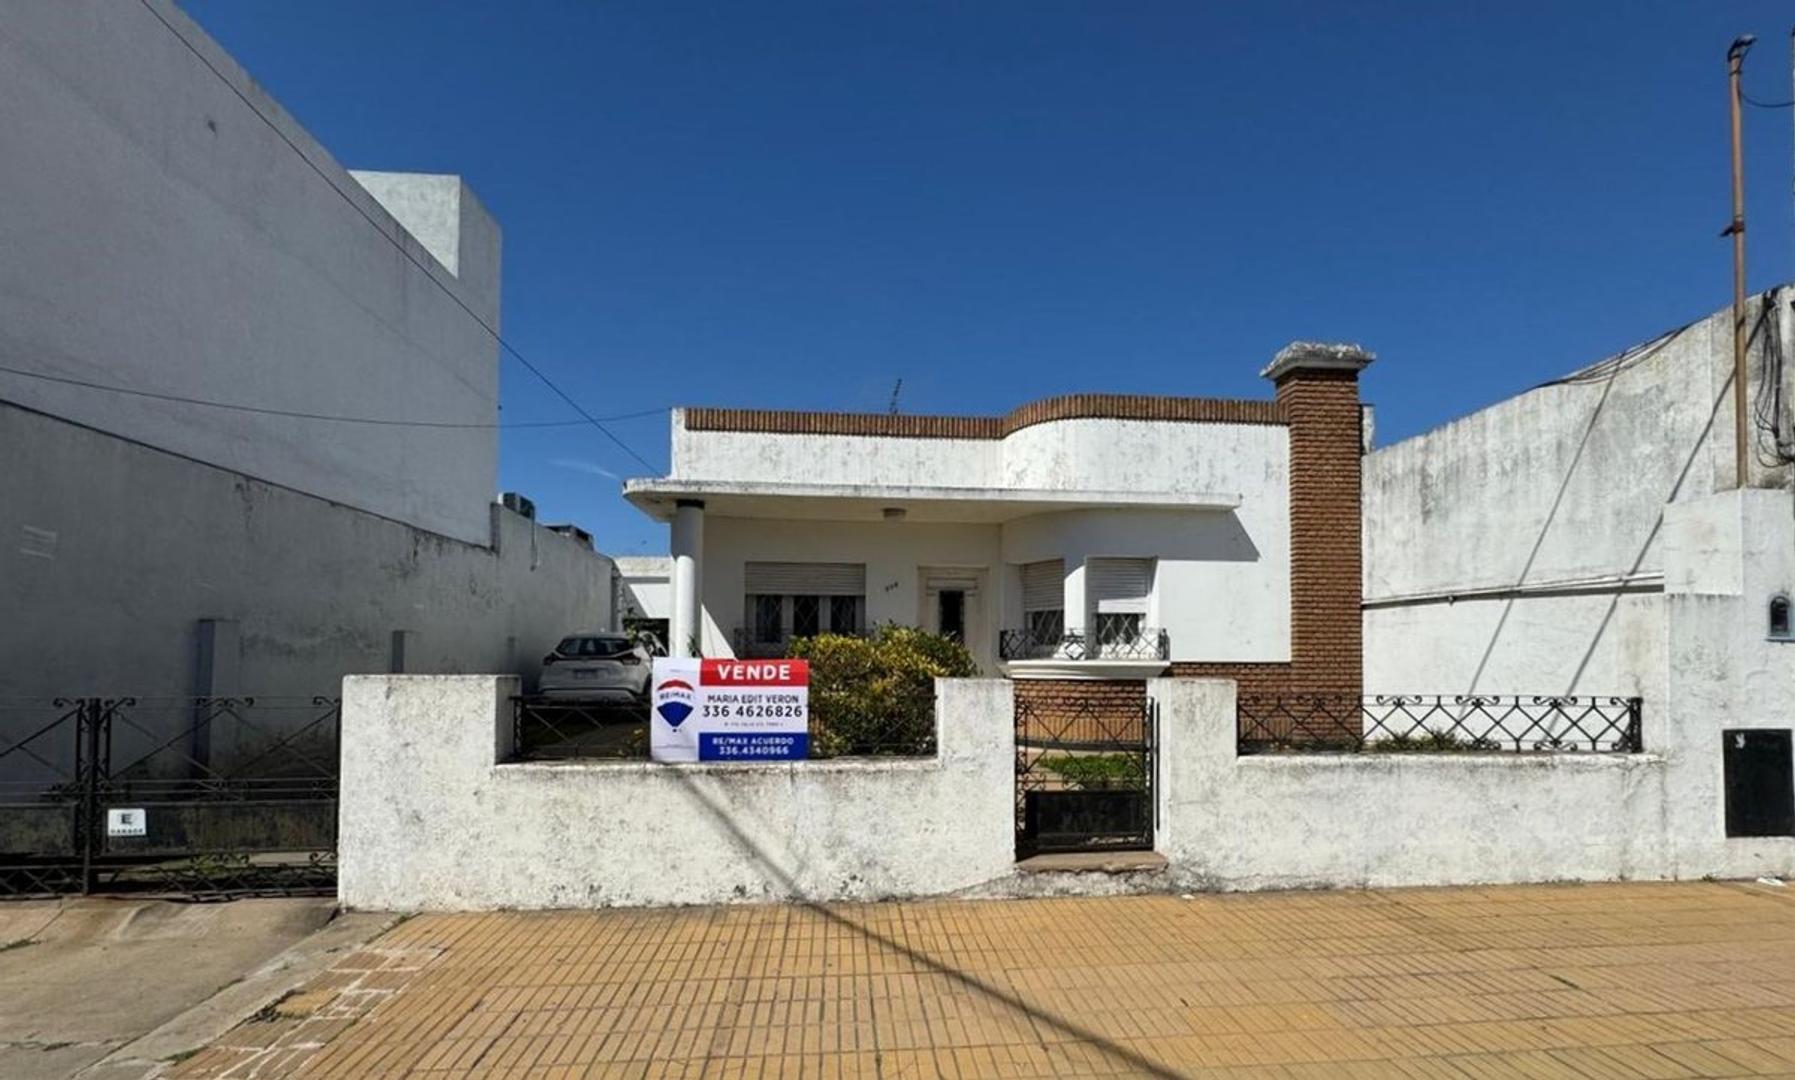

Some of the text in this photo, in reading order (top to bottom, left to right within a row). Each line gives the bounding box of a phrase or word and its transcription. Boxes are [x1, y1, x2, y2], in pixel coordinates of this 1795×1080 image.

[717, 664, 791, 680] VENDE
[707, 695, 799, 703] MARIA EDIT VERON
[702, 705, 803, 717] 336 4626826
[712, 737, 795, 745] RE/MAX ACUERDO
